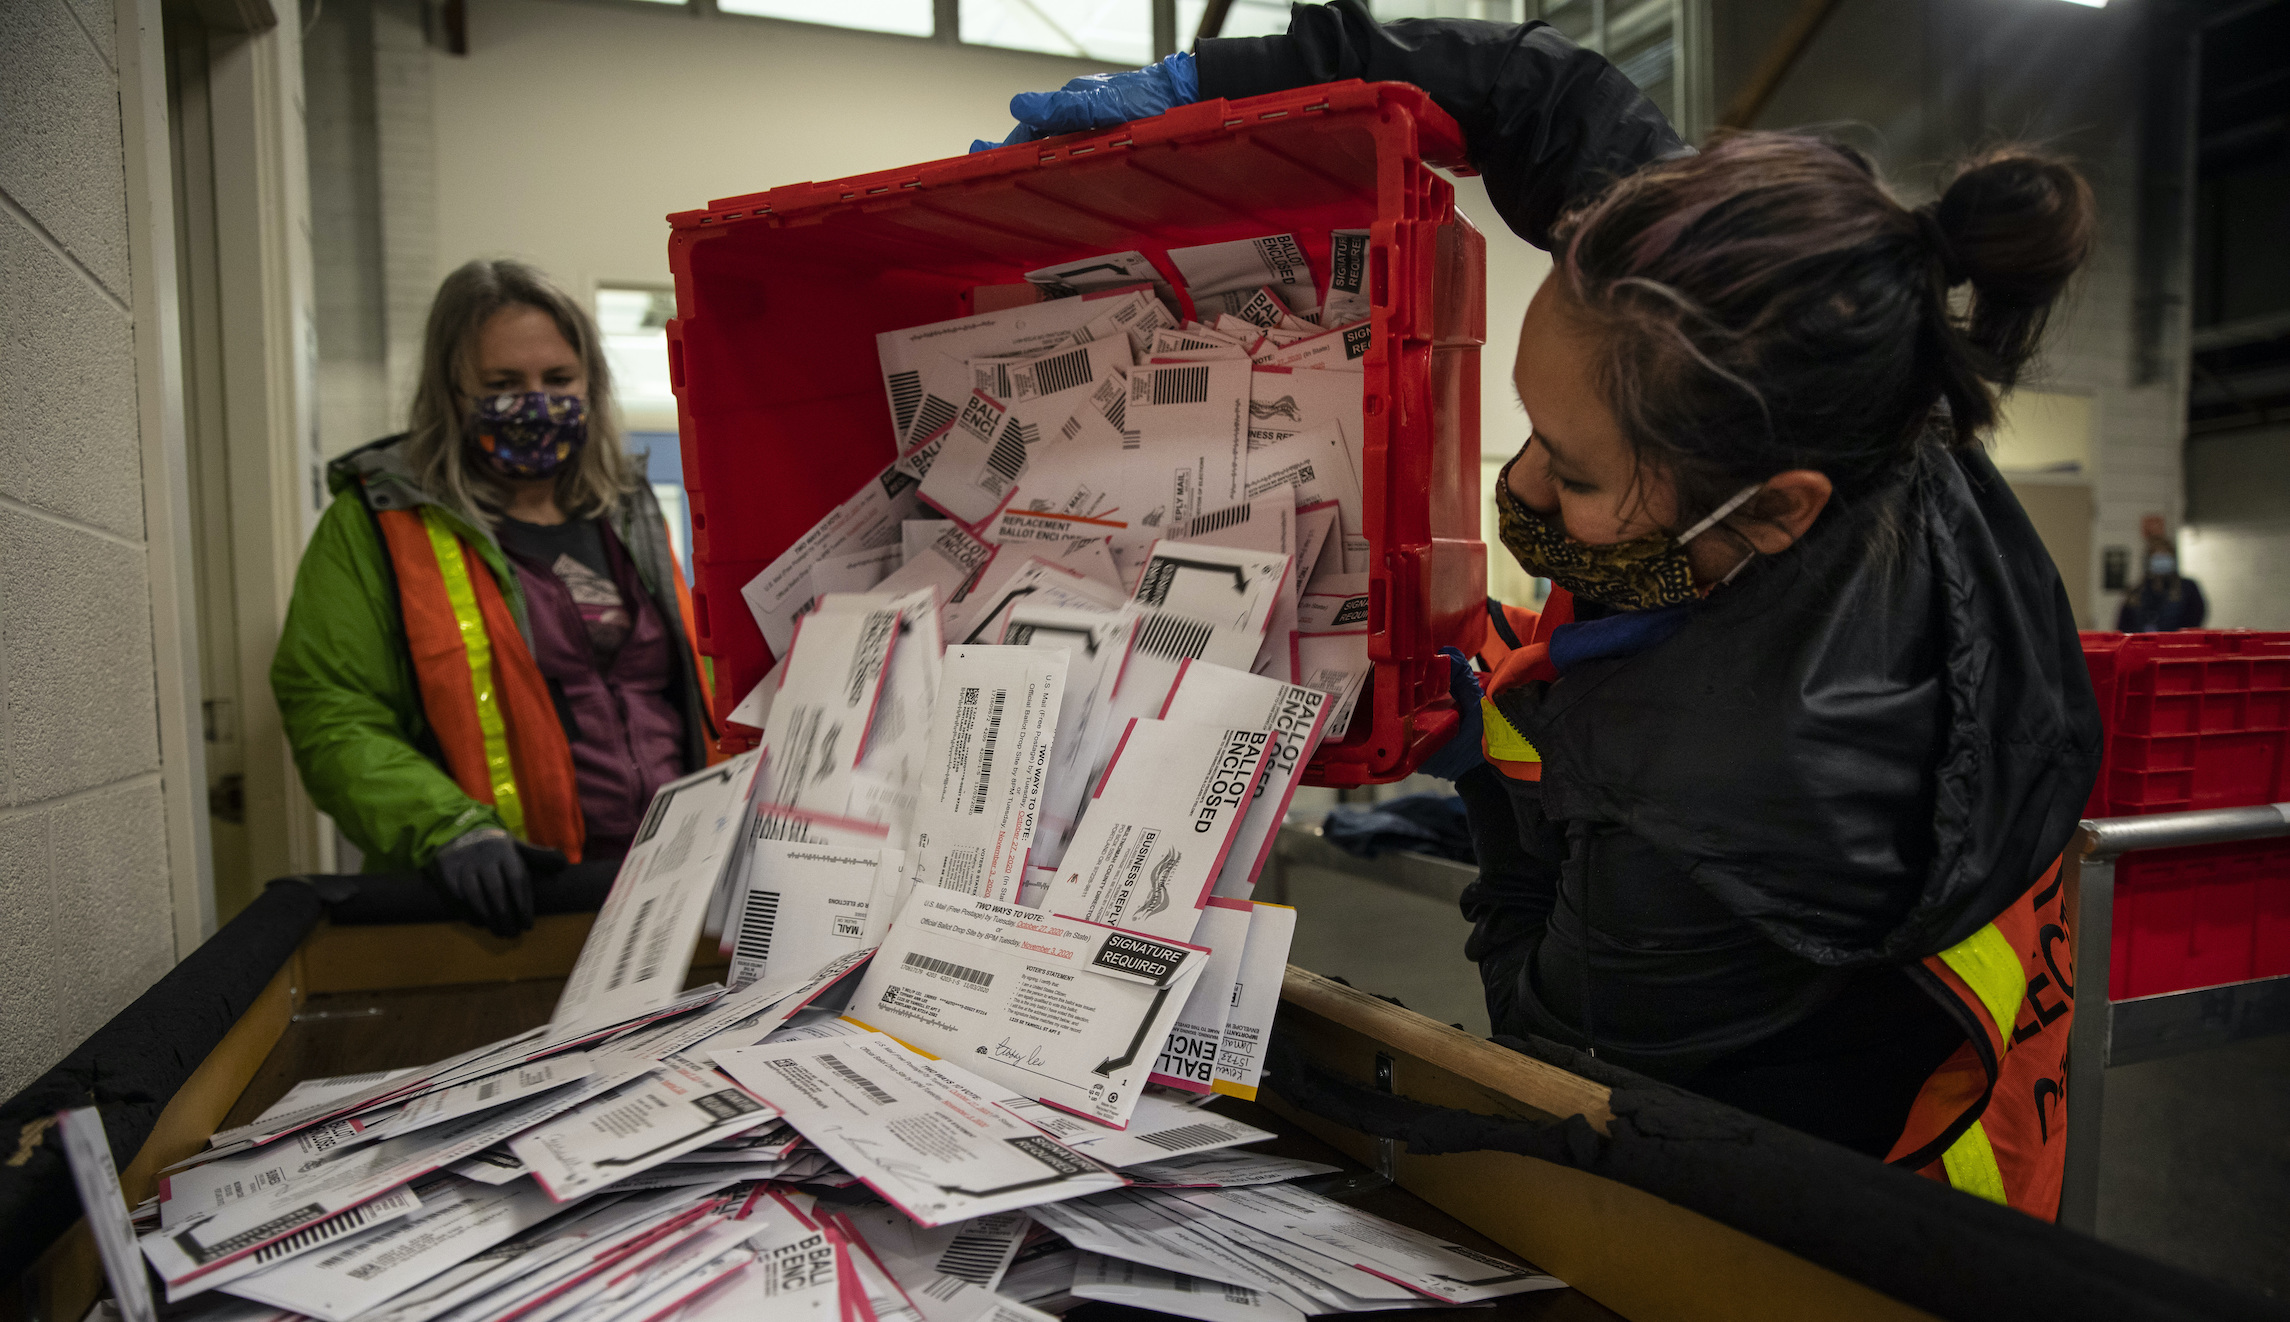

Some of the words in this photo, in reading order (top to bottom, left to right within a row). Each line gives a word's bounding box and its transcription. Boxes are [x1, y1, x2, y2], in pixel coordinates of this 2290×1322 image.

[1262, 237, 1296, 285] ENCLOSED
[1000, 527, 1035, 539] BALLOT
[1002, 516, 1072, 532] REPLACEMENT
[1025, 682, 1036, 708] Official
[1043, 673, 1052, 691] U.S.
[1040, 692, 1048, 708] Mail
[1021, 709, 1030, 730] Ballot
[1035, 709, 1045, 729] (Free
[1016, 731, 1025, 749] Drop
[1277, 691, 1323, 775] BALLOT
[1013, 750, 1022, 765] Site
[1028, 730, 1041, 764] Postage)
[1037, 743, 1047, 766] TWO
[1011, 766, 1018, 776] by
[1026, 765, 1034, 775] by
[1031, 767, 1042, 795] WAYS
[1195, 730, 1251, 833] ENCLOSED
[1224, 732, 1267, 808] BALLOT
[1008, 777, 1016, 795] 8PM
[1019, 776, 1032, 809] Tuesday,
[999, 796, 1012, 830] Tuesday,
[1028, 796, 1036, 810] TO
[1013, 809, 1025, 840] October
[1021, 811, 1033, 842] VOTE:
[990, 830, 1005, 869] November
[1100, 822, 1119, 855] PORTLAND
[1110, 824, 1132, 863] MULTNOMAH
[1005, 854, 1014, 874] 2020
[1122, 832, 1156, 888] BUSINESS
[1001, 875, 1010, 887] (In
[1098, 863, 1114, 889] COUNTY
[827, 897, 856, 907] ELECTIONS
[975, 900, 991, 910] TWO
[991, 904, 1012, 915] WAYS
[1012, 909, 1023, 918] TO
[1023, 911, 1044, 923] VOTE:
[1107, 889, 1130, 926] REPLY
[836, 923, 859, 935] MAIL
[934, 901, 946, 910] Mail
[945, 904, 960, 914] (Free
[959, 907, 985, 920] Postage)
[991, 914, 1016, 927] Tuesday,
[1015, 919, 1038, 931] October
[1048, 926, 1064, 937] 2020
[1062, 930, 1072, 938] (In
[1072, 931, 1091, 942] State)
[919, 917, 937, 927] Official
[937, 921, 952, 930] Ballot
[951, 925, 965, 934] Drop
[966, 928, 976, 936] Site
[984, 932, 998, 942] 8PM
[998, 936, 1021, 948] Tuesday,
[1021, 940, 1050, 954] November
[1057, 948, 1073, 960] 2020
[1109, 935, 1182, 964] SIGNATURE
[1025, 964, 1046, 974] VOTER'S
[1045, 969, 1074, 982] STATEMENT
[1102, 951, 1167, 977] REQUIRED
[1015, 1140, 1078, 1174] REQUIRED
[1032, 1136, 1100, 1173] SIGNATURE
